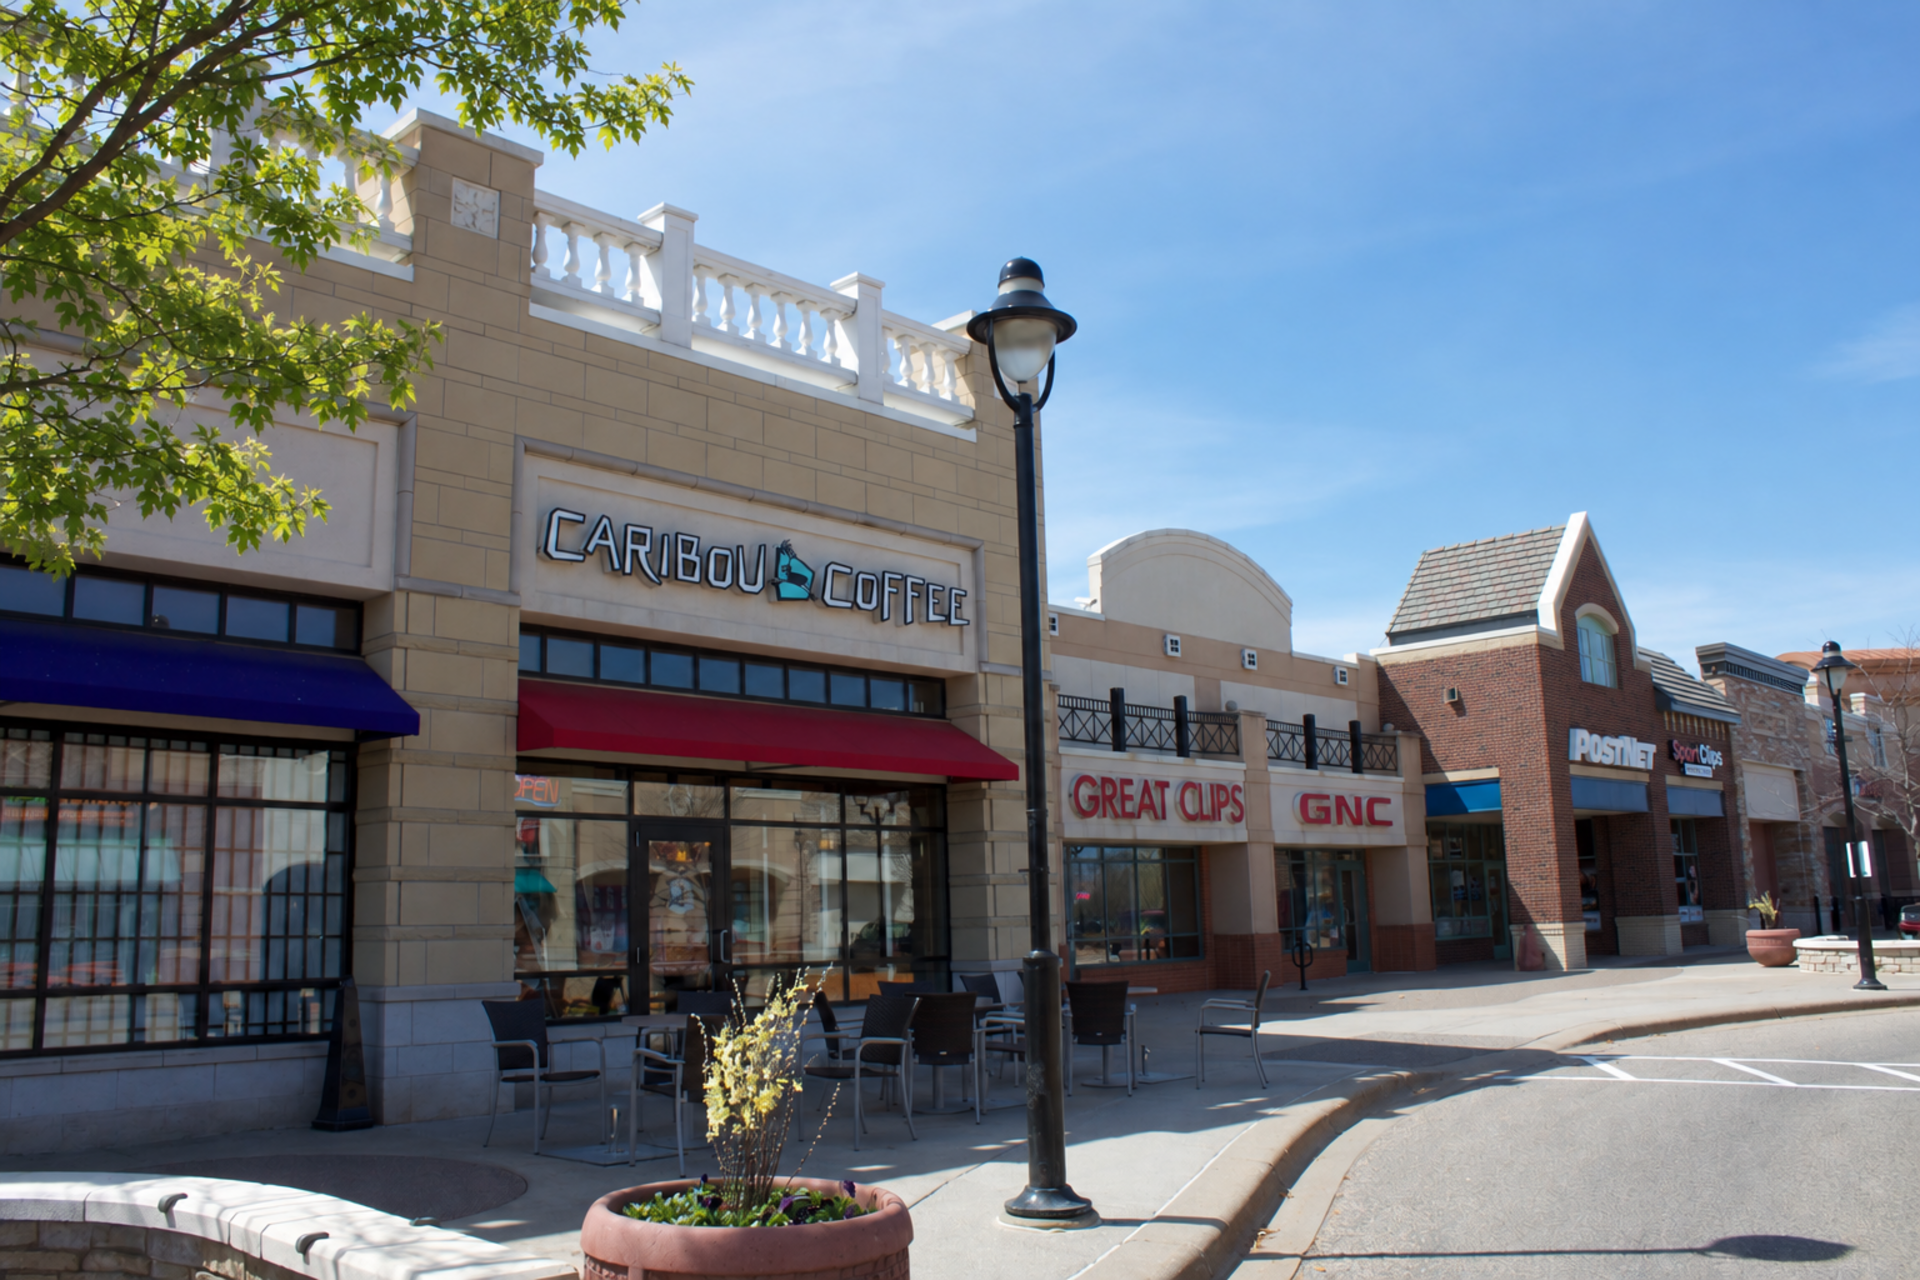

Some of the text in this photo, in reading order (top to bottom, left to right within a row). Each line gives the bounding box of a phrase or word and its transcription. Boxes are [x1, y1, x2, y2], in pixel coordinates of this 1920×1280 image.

[544, 507, 971, 626] CARIBOU COFFEE
[1072, 774, 1246, 824] GREAT CLIPS
[1298, 793, 1393, 827] GNC
